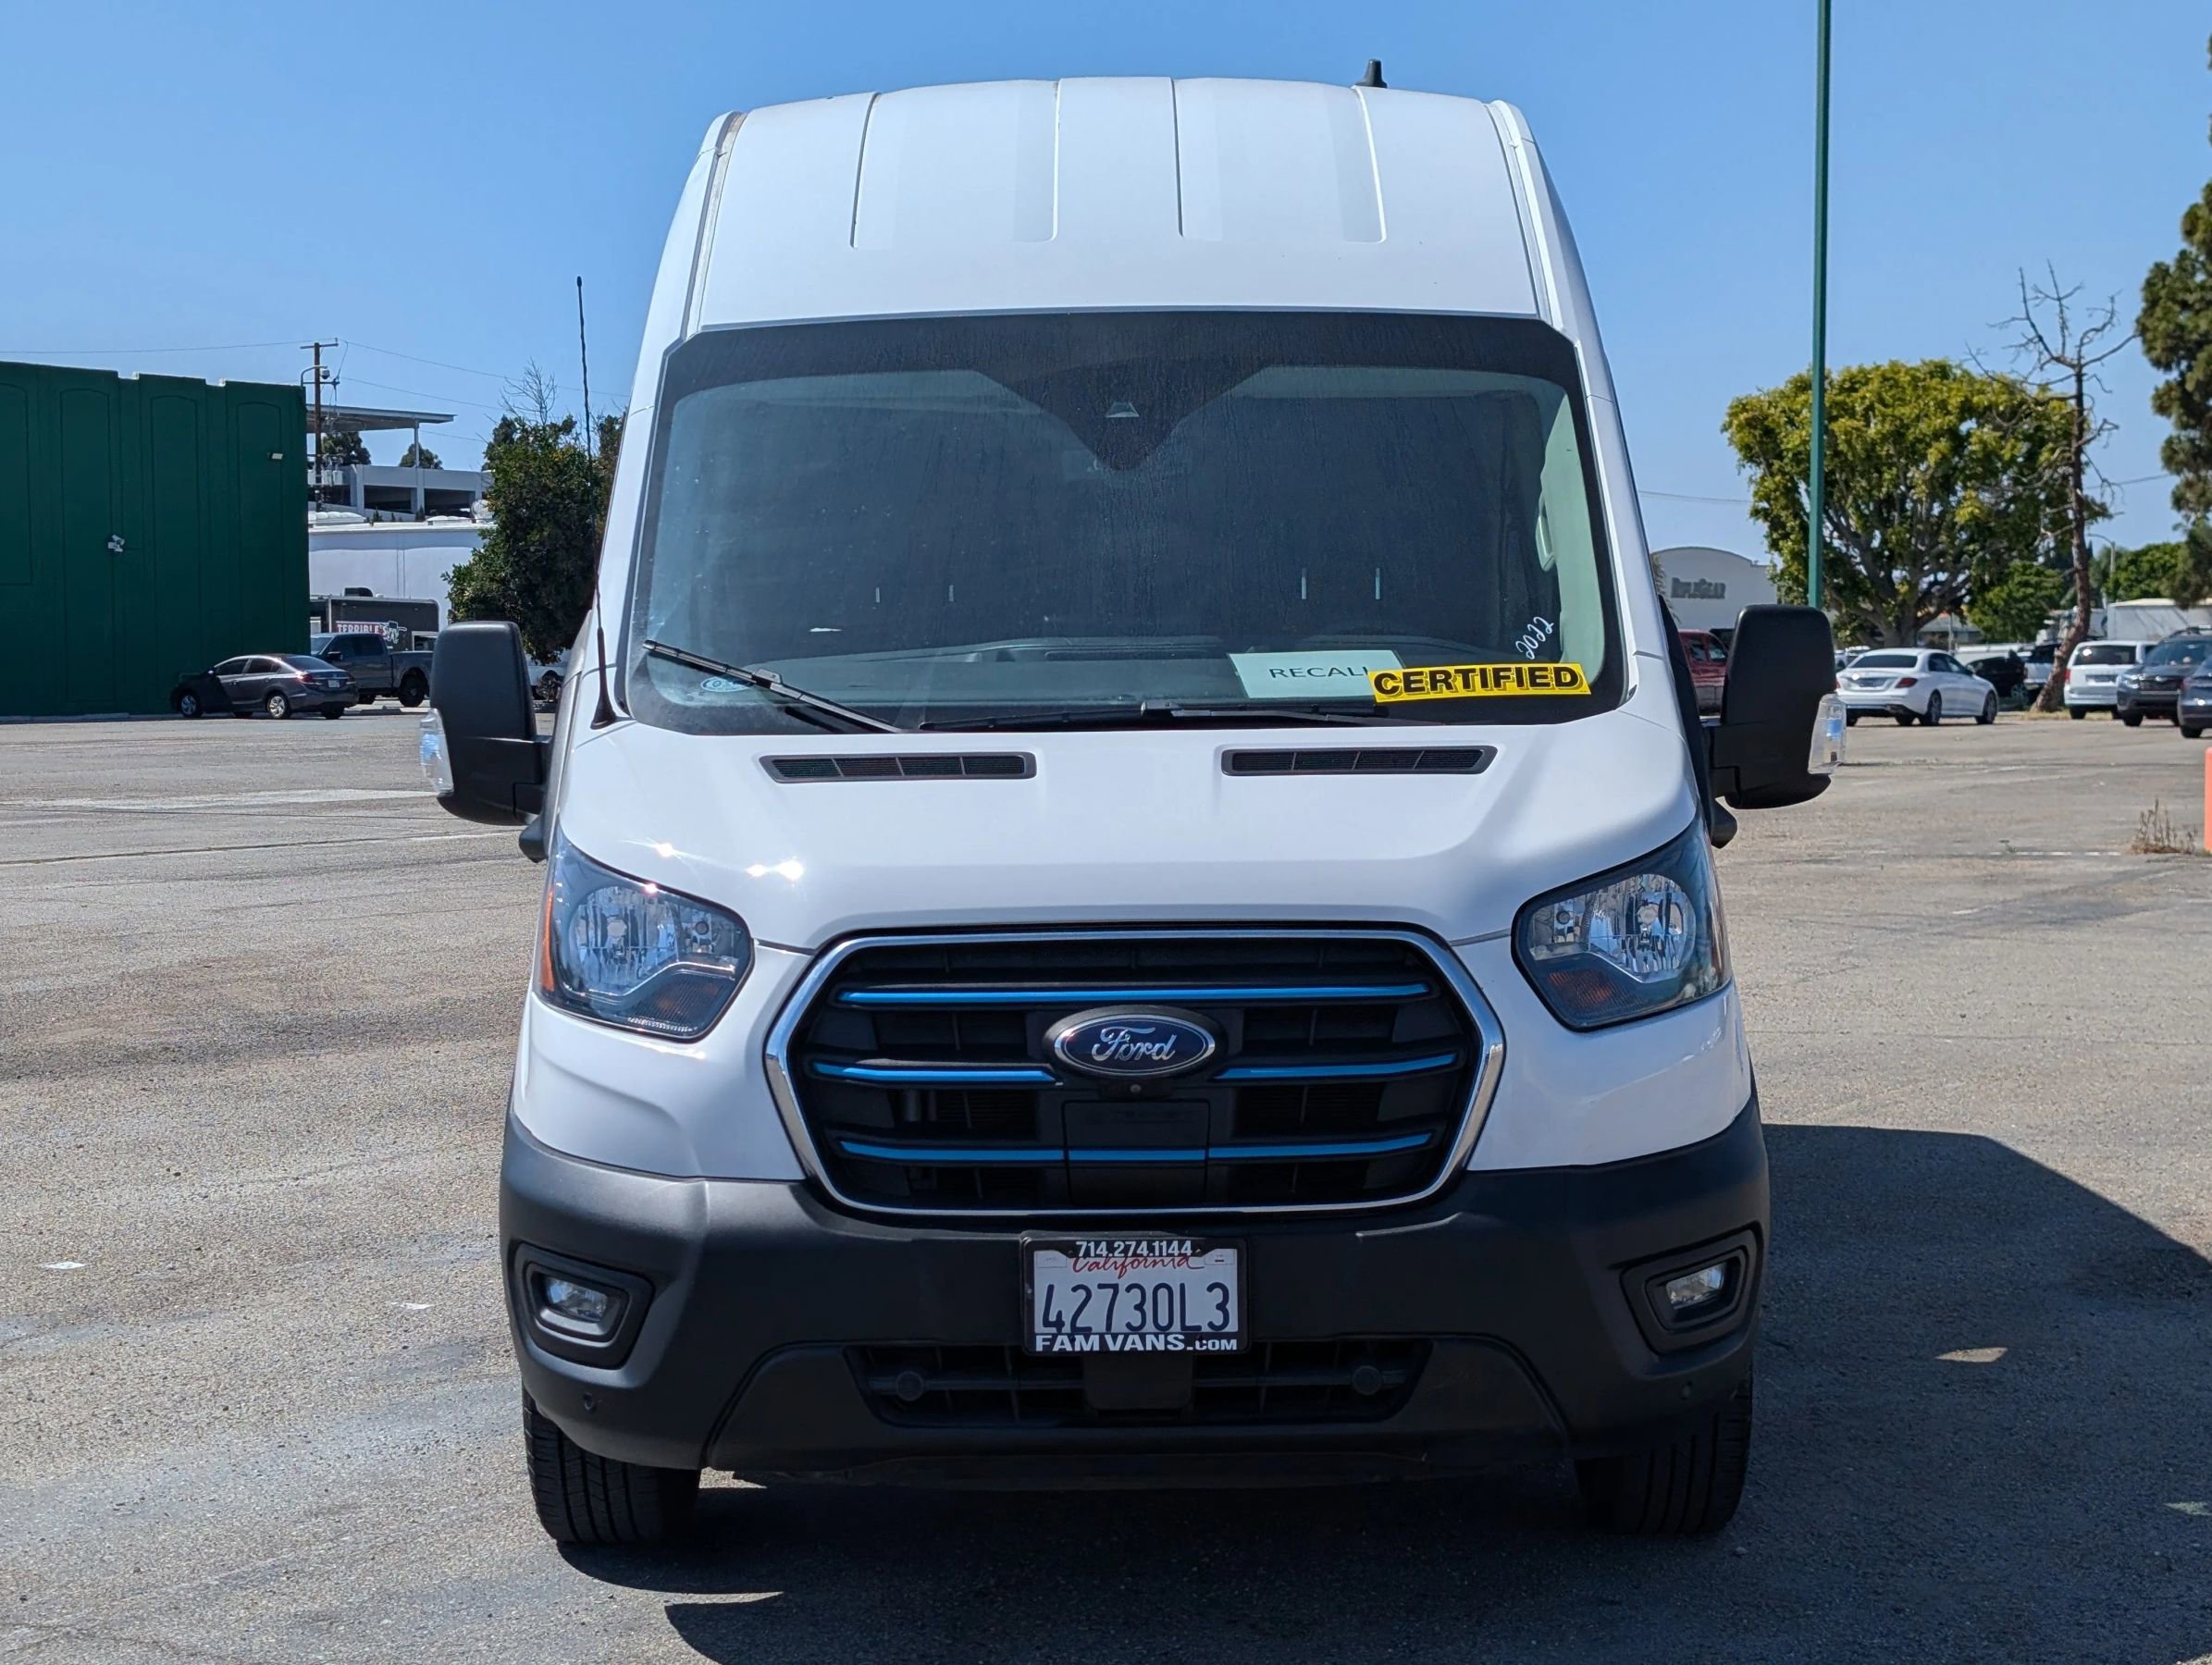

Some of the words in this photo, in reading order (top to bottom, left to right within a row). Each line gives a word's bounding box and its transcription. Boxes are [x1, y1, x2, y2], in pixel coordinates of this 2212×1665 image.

[1515, 616, 1554, 660] 2022
[1373, 666, 1581, 696] CERTIFIED
[1091, 1026, 1178, 1062] Ford
[1075, 1240, 1193, 1258] 714.274.1144
[1072, 1255, 1205, 1280] California
[1042, 1281, 1230, 1333] 42730L3
